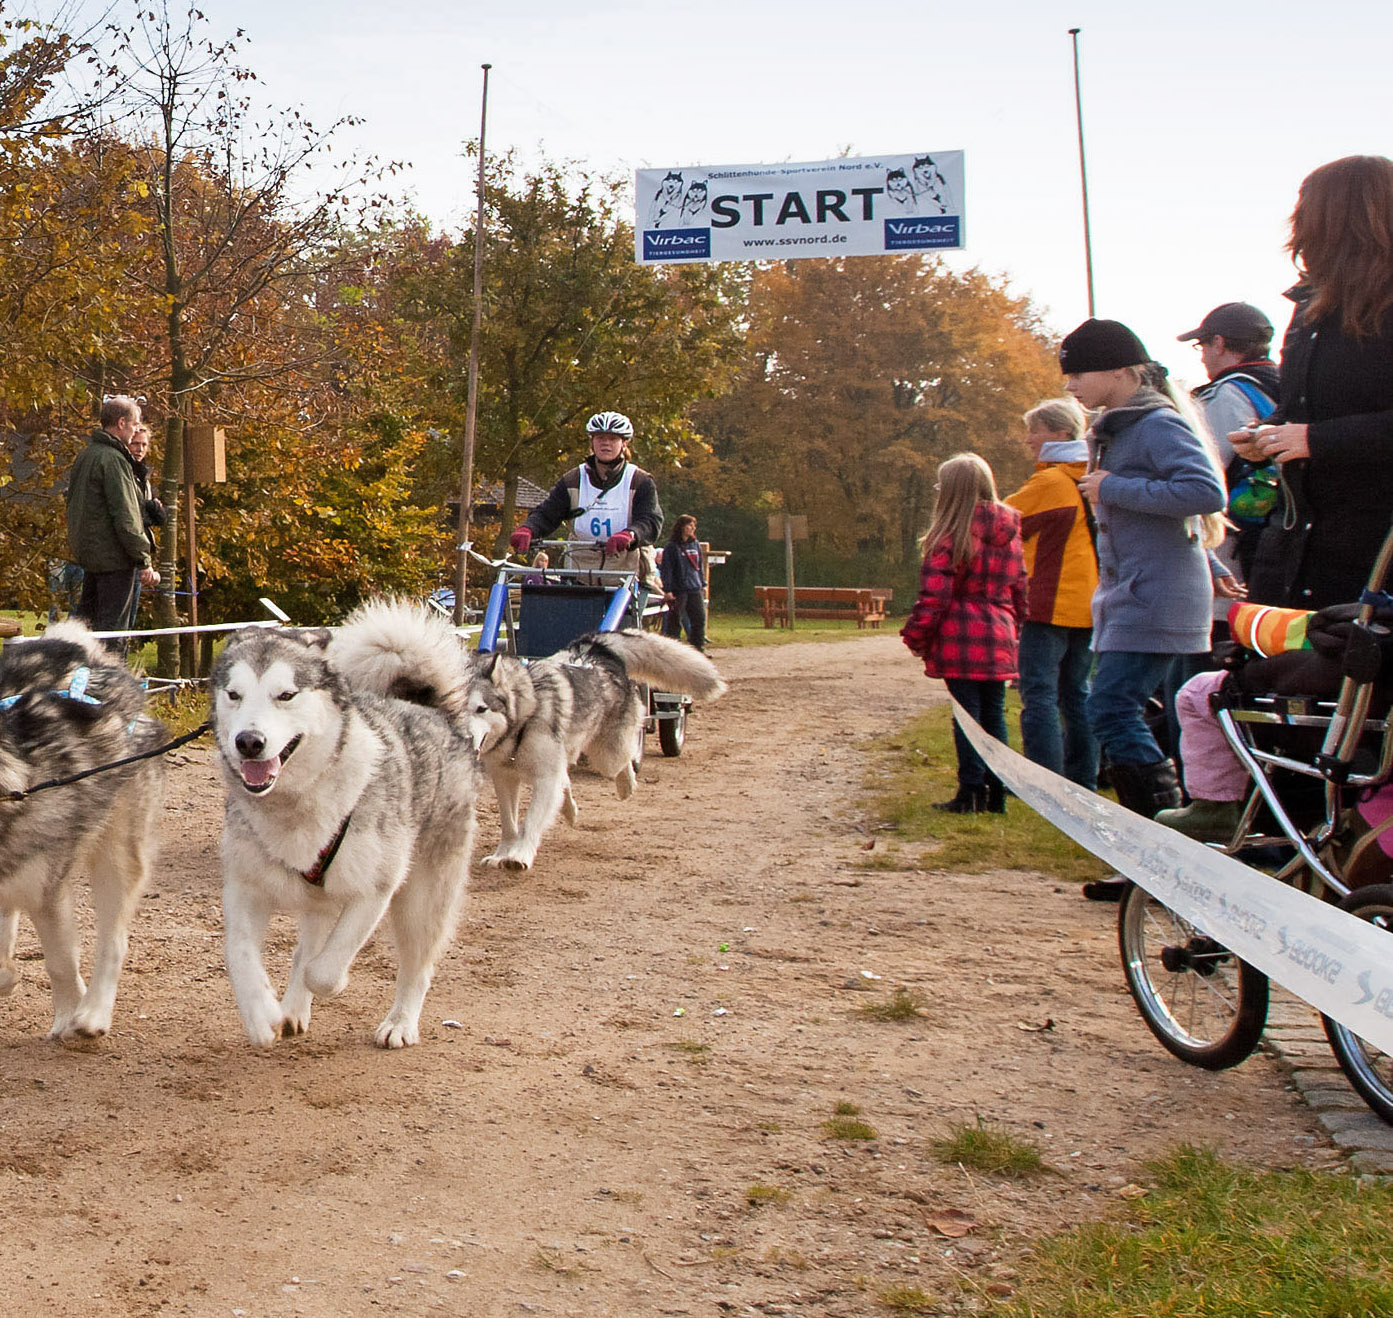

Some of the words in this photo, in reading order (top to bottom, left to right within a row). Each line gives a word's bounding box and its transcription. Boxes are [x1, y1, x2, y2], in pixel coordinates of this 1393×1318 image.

[839, 163, 862, 172] Nord
[865, 162, 884, 170] e.V.
[711, 187, 884, 228] START
[889, 223, 955, 234] Virbac
[647, 235, 706, 245] Virbac
[743, 234, 847, 247] www.ssvnord.de
[591, 517, 611, 537] 61
